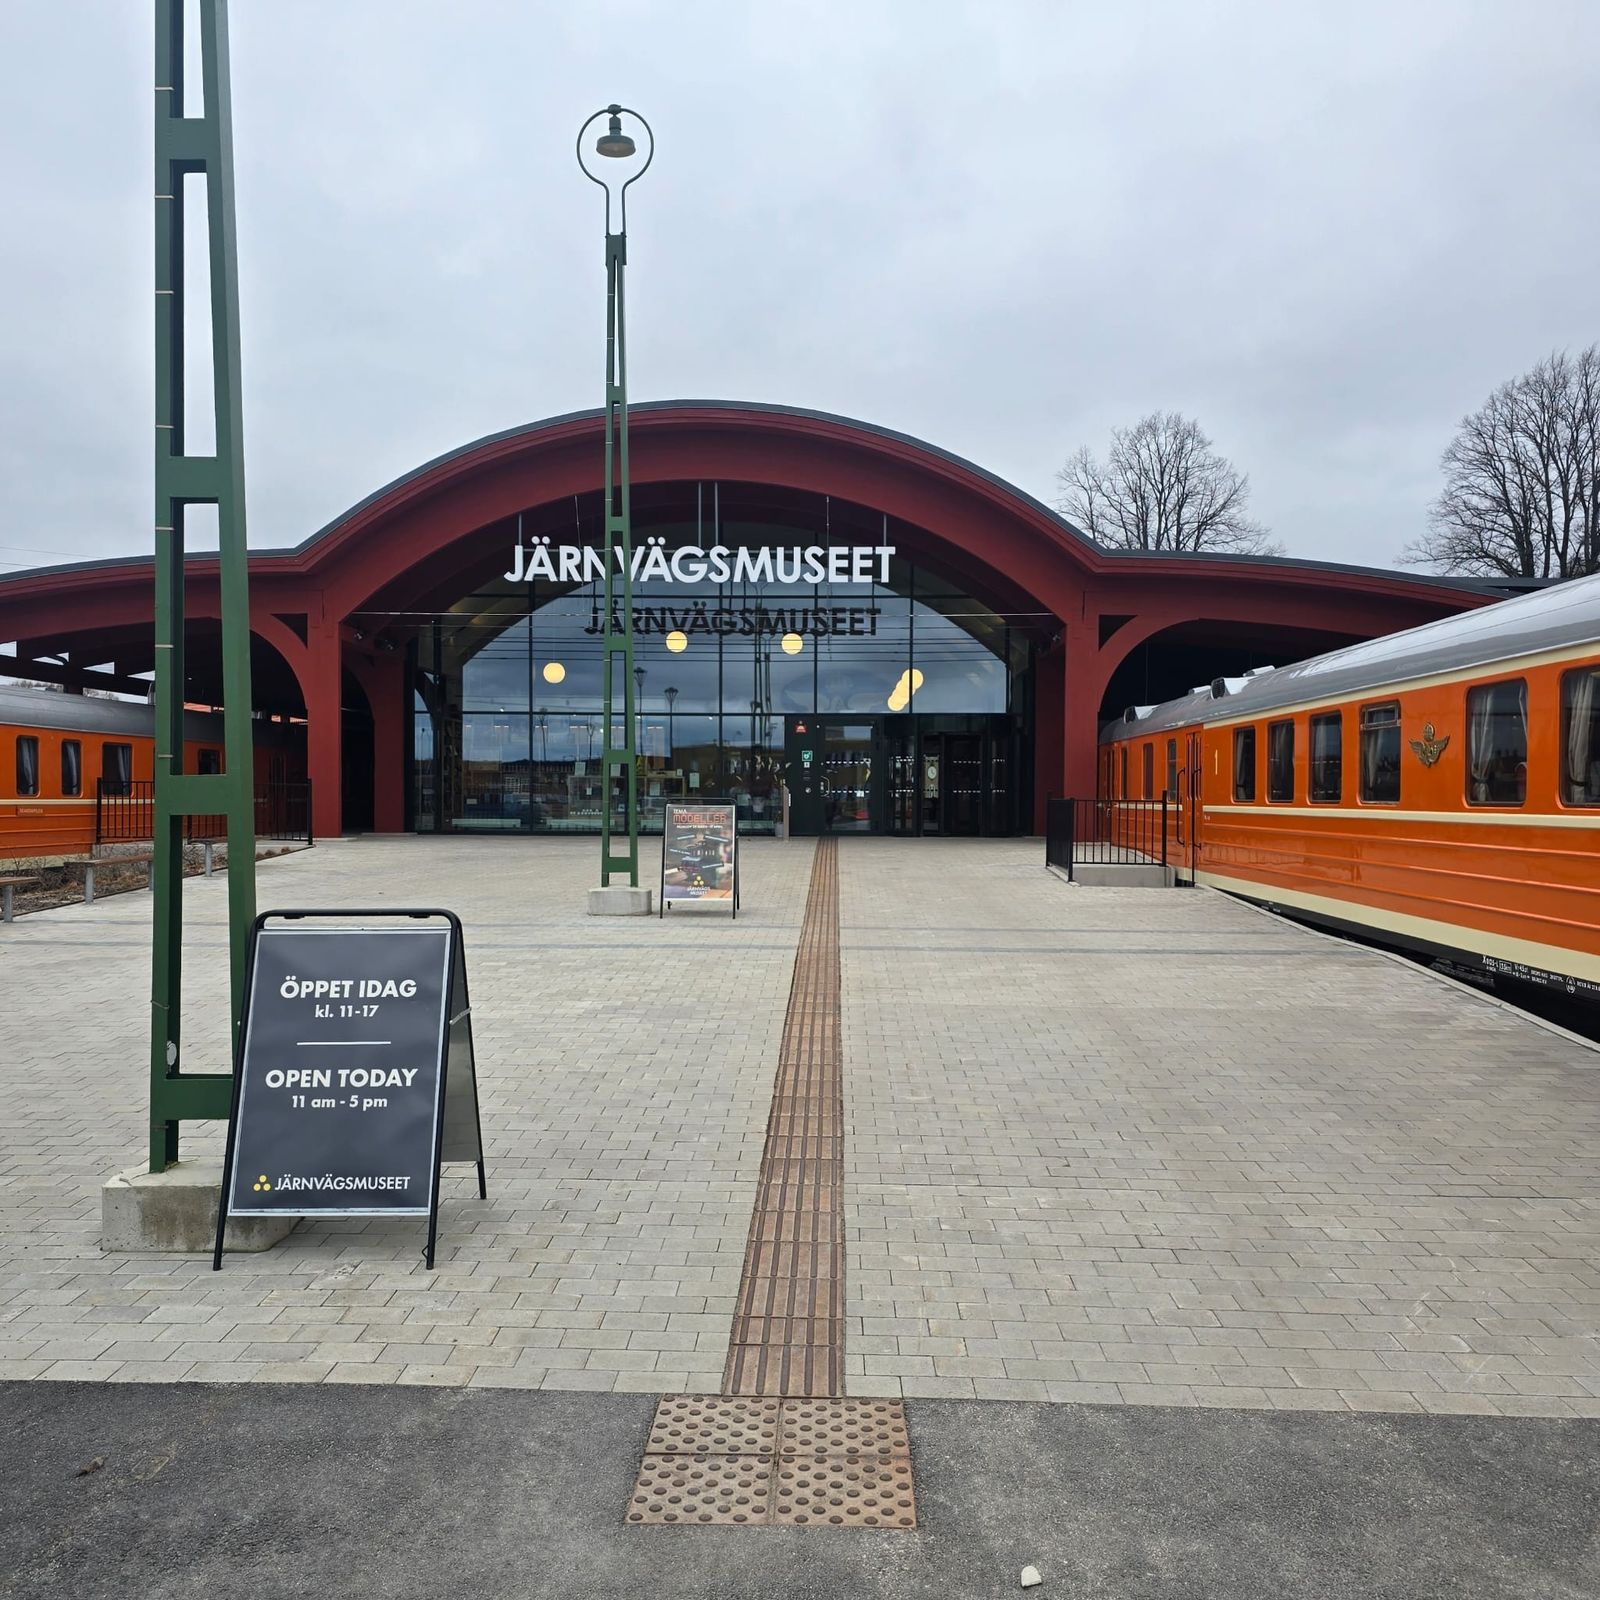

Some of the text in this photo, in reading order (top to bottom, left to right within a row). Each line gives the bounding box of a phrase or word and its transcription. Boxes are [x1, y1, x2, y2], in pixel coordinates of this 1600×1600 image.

[504, 535, 896, 584] JÄRNVÄGSMUSEET
[673, 814, 727, 824] MODELLER
[280, 975, 417, 998] ÖPPET IDAG
[315, 1004, 380, 1019] kl. 11-17
[265, 1068, 419, 1088] OPEN TODAY
[291, 1095, 306, 1108] 11
[311, 1097, 336, 1108] am
[349, 1095, 359, 1108] 5
[363, 1097, 388, 1112] pm
[274, 1174, 411, 1191] JÄRNVÄGSMUSEET
